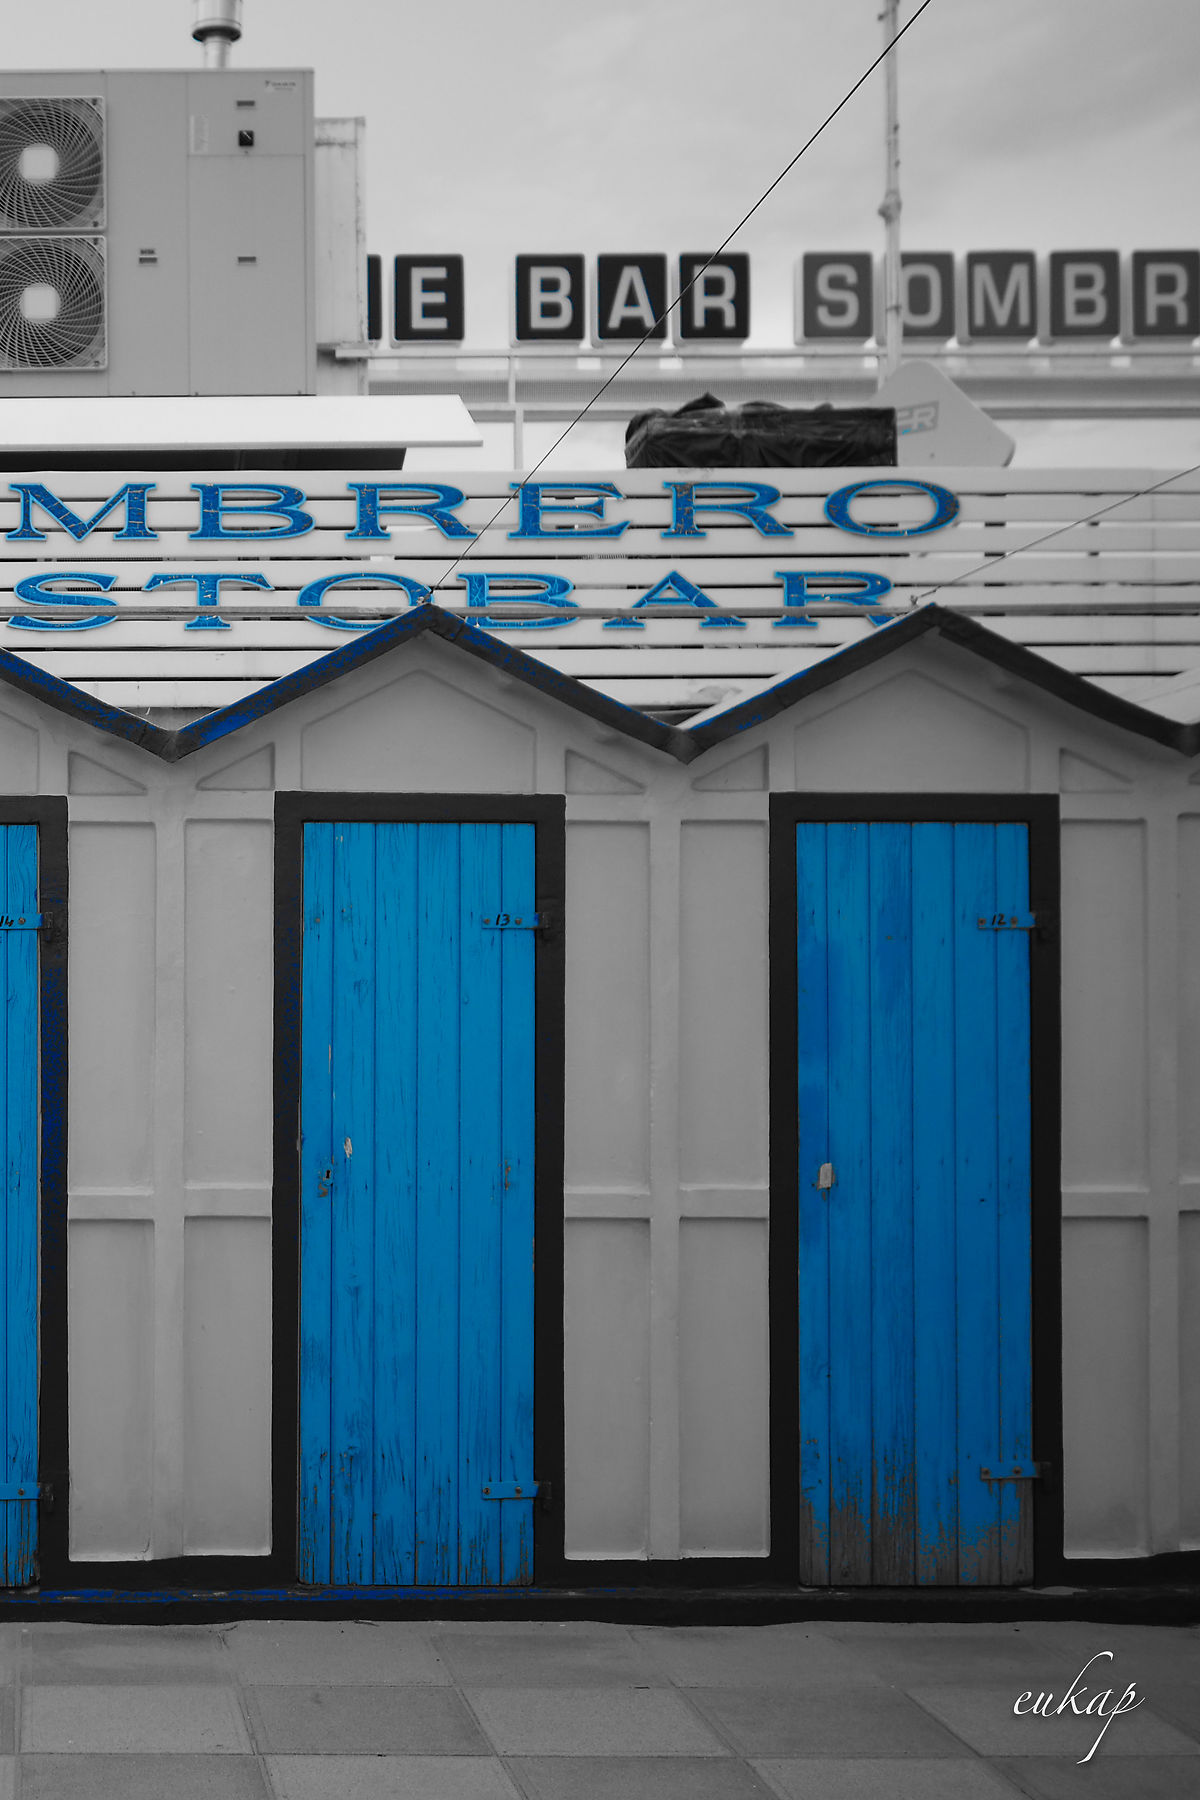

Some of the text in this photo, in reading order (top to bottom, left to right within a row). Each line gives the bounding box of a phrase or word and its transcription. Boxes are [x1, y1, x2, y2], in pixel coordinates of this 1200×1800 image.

[530, 265, 736, 330] BAR
[0, 915, 15, 928] 14
[495, 913, 511, 927] 13
[991, 913, 1006, 926] 12
